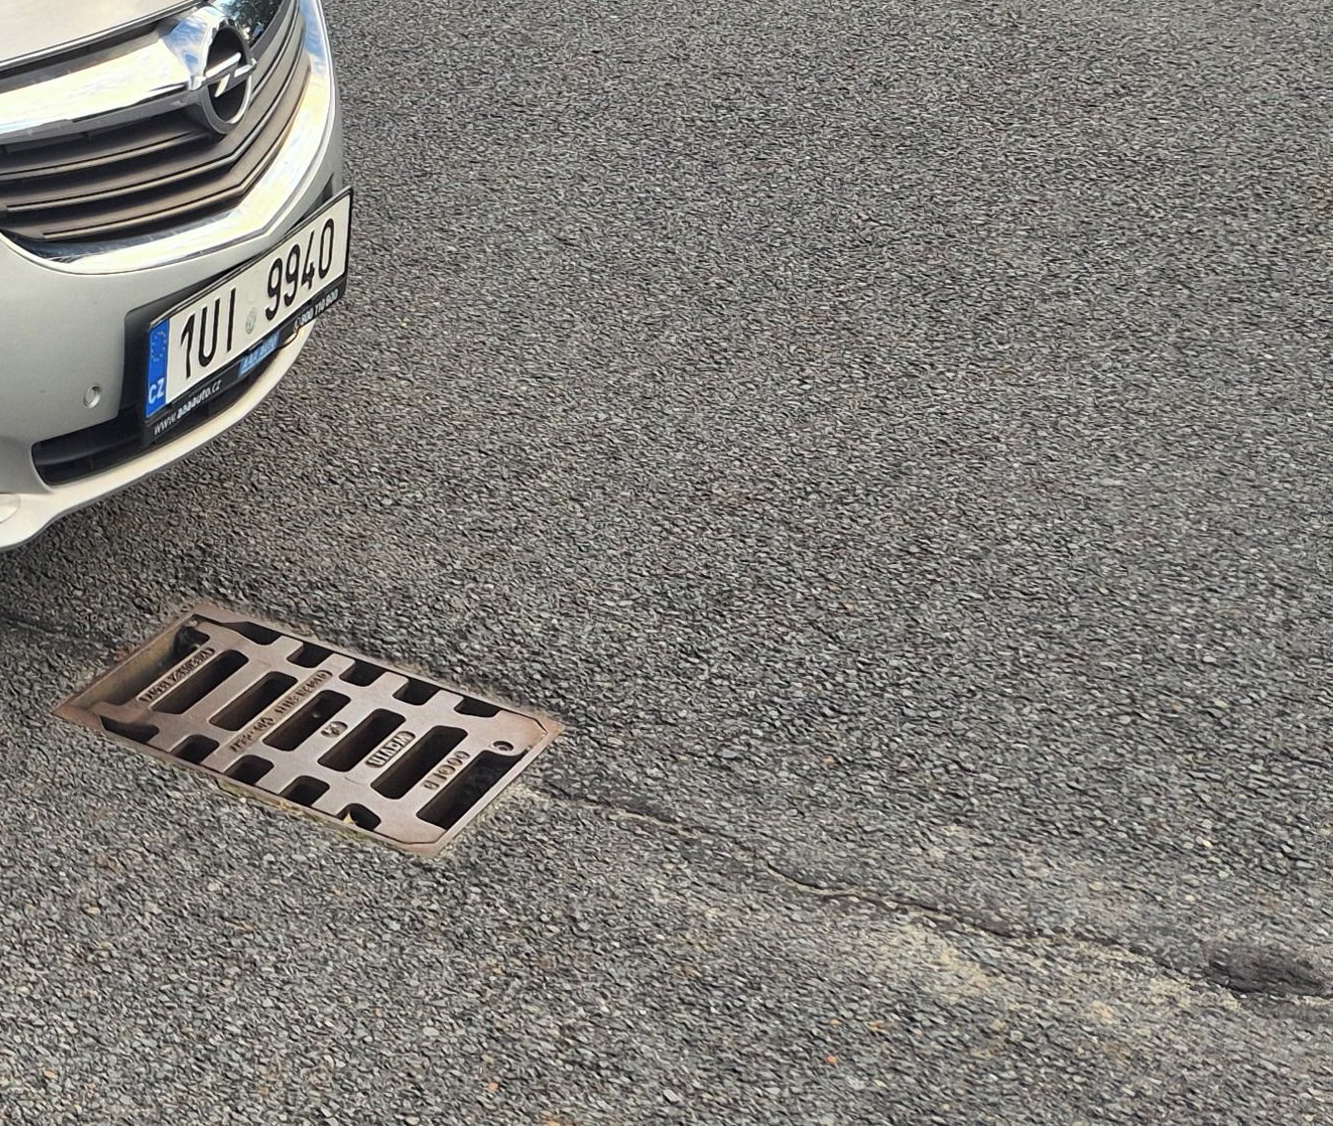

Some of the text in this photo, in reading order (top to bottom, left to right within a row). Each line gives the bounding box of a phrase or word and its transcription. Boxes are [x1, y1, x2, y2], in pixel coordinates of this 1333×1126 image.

[180, 218, 334, 379] 1UI 9940
[148, 377, 165, 404] CZ
